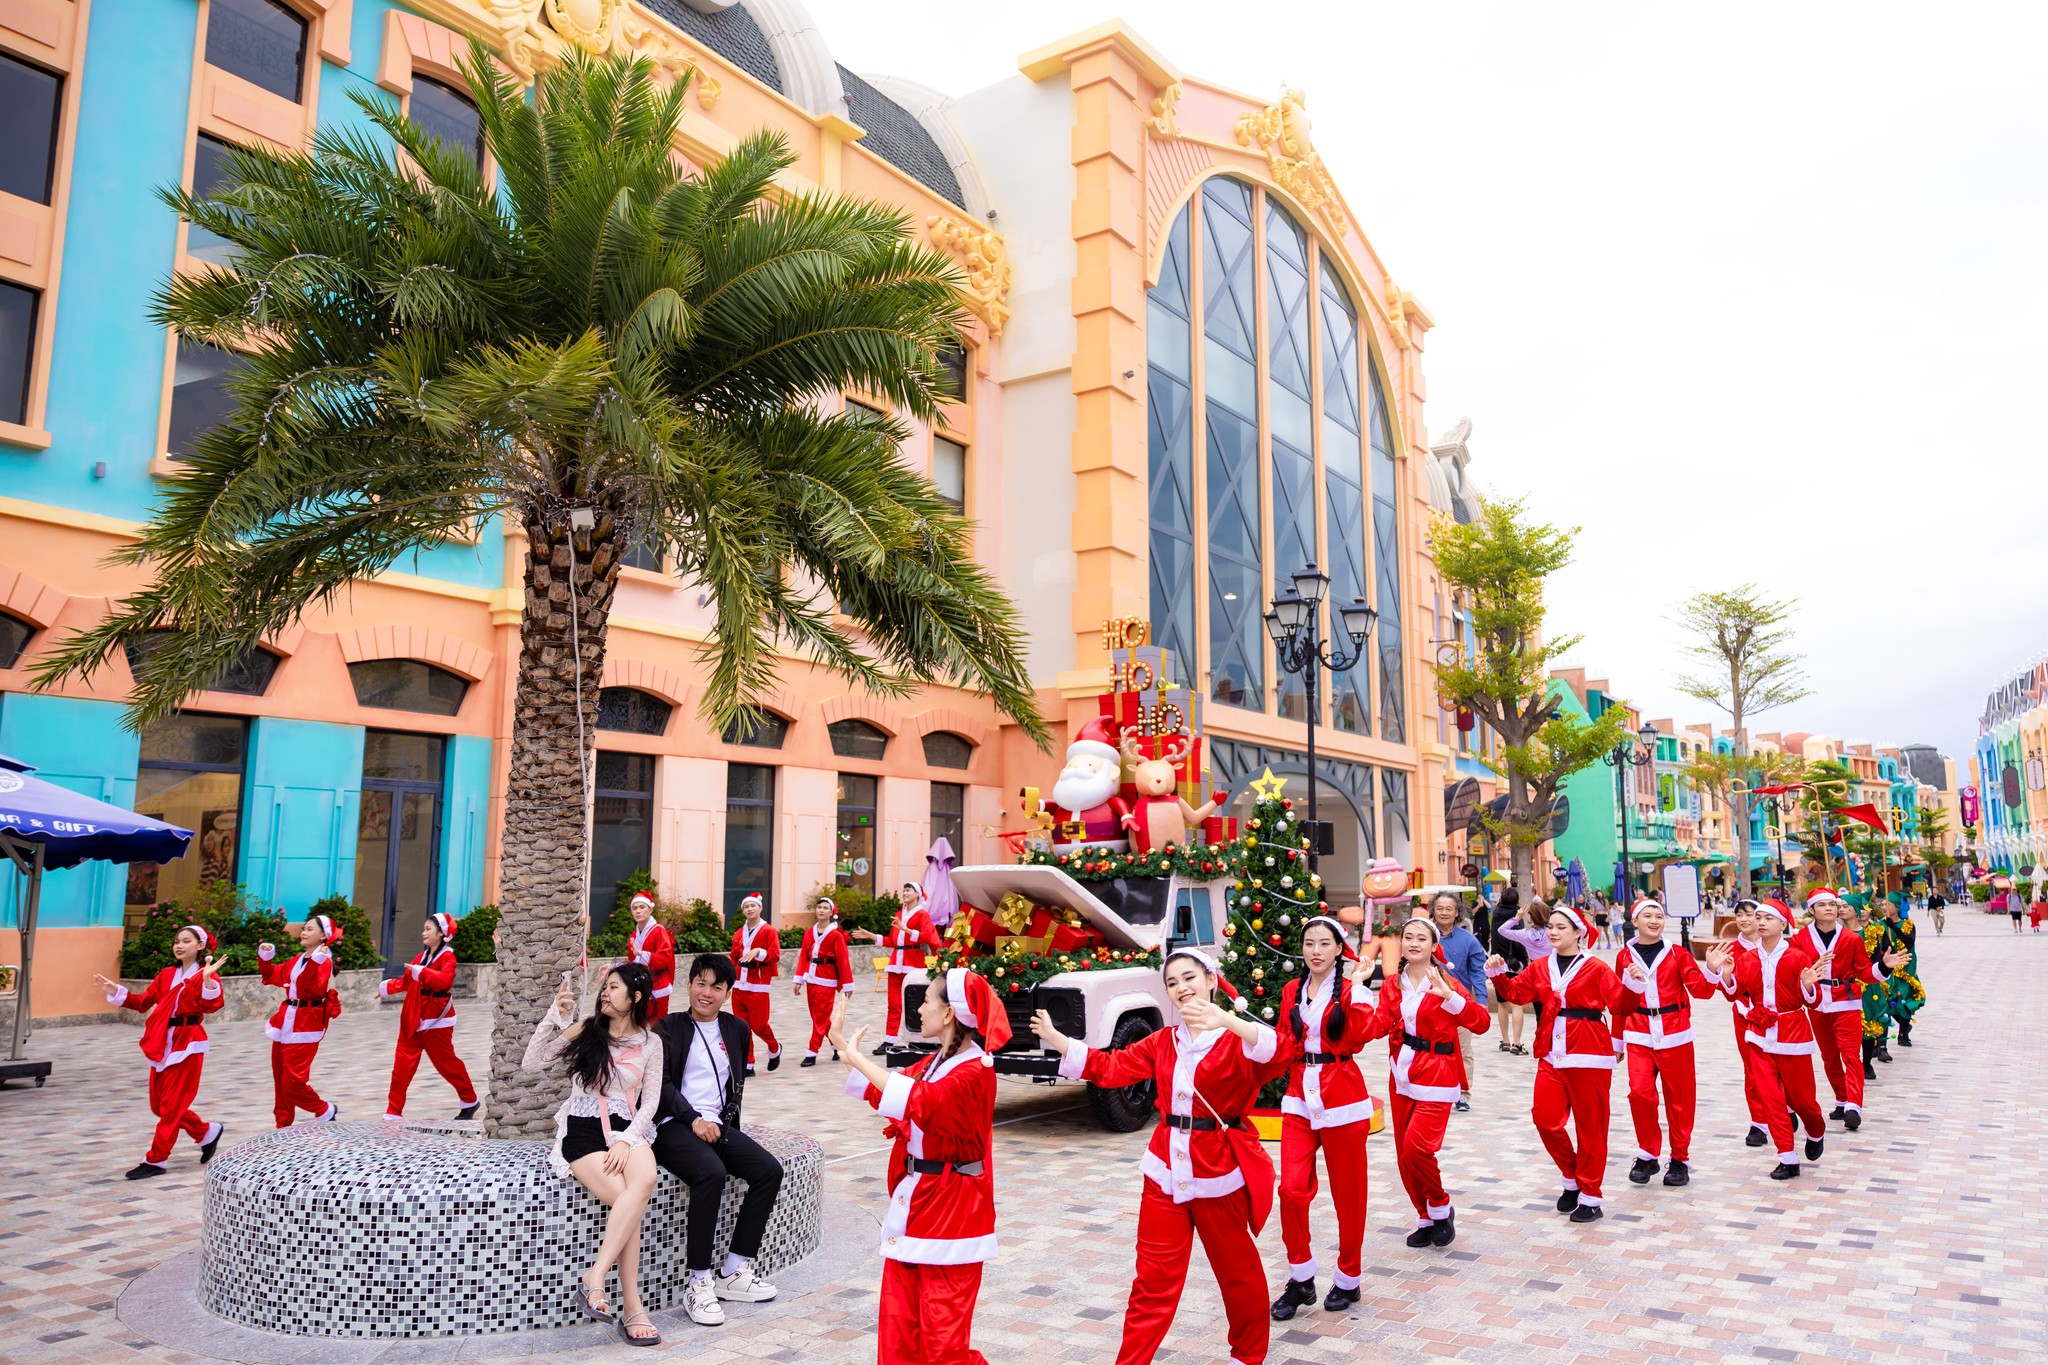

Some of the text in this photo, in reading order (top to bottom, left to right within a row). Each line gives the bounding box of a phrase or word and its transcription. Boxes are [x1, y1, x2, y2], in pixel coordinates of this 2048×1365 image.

[1102, 617, 1146, 649] HO
[1109, 661, 1153, 693] HO
[1138, 704, 1184, 737] HO
[30, 818, 44, 828] &
[52, 820, 97, 833] GIFT
